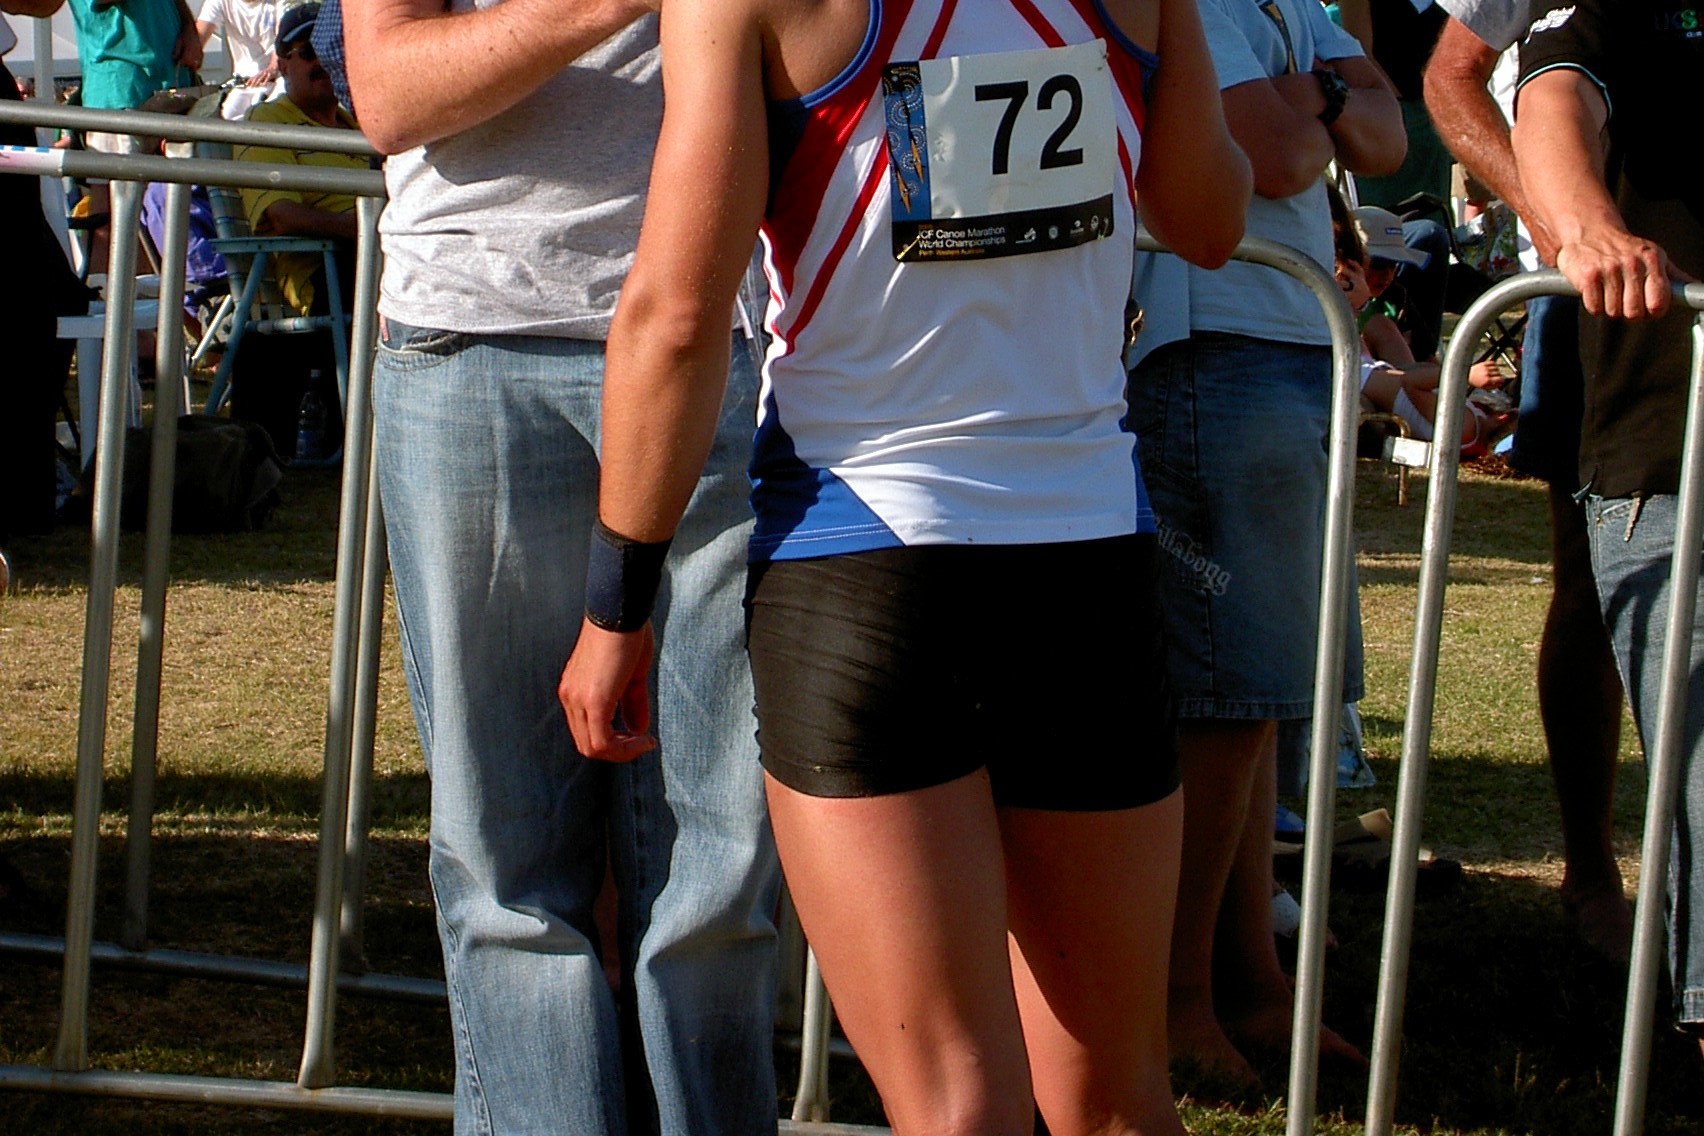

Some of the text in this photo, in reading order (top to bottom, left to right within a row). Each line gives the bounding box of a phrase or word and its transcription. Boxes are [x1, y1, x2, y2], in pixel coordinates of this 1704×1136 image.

[975, 74, 1083, 175] 72
[918, 225, 1006, 240] ICF Canoe Marathon
[918, 236, 1006, 250] World Championships
